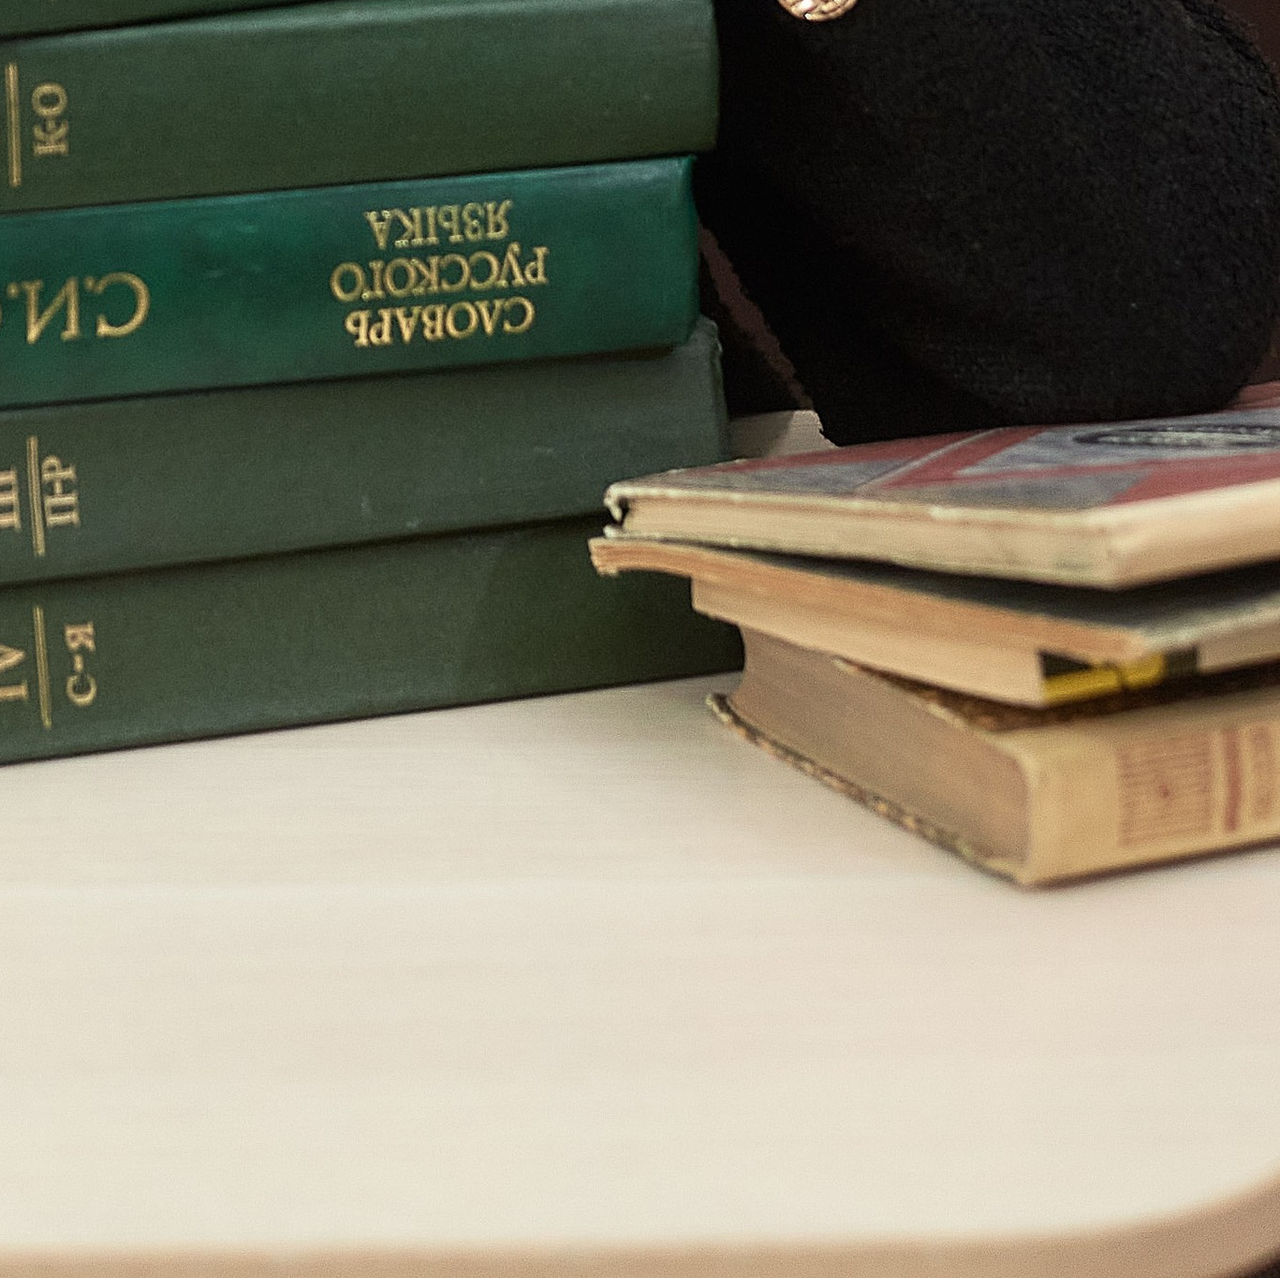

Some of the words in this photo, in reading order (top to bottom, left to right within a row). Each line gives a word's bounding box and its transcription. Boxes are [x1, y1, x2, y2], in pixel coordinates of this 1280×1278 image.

[363, 199, 514, 251] ЯЗЫКА
[329, 241, 550, 303] РУССКОГО
[344, 296, 537, 348] СЛОВАРЬ
